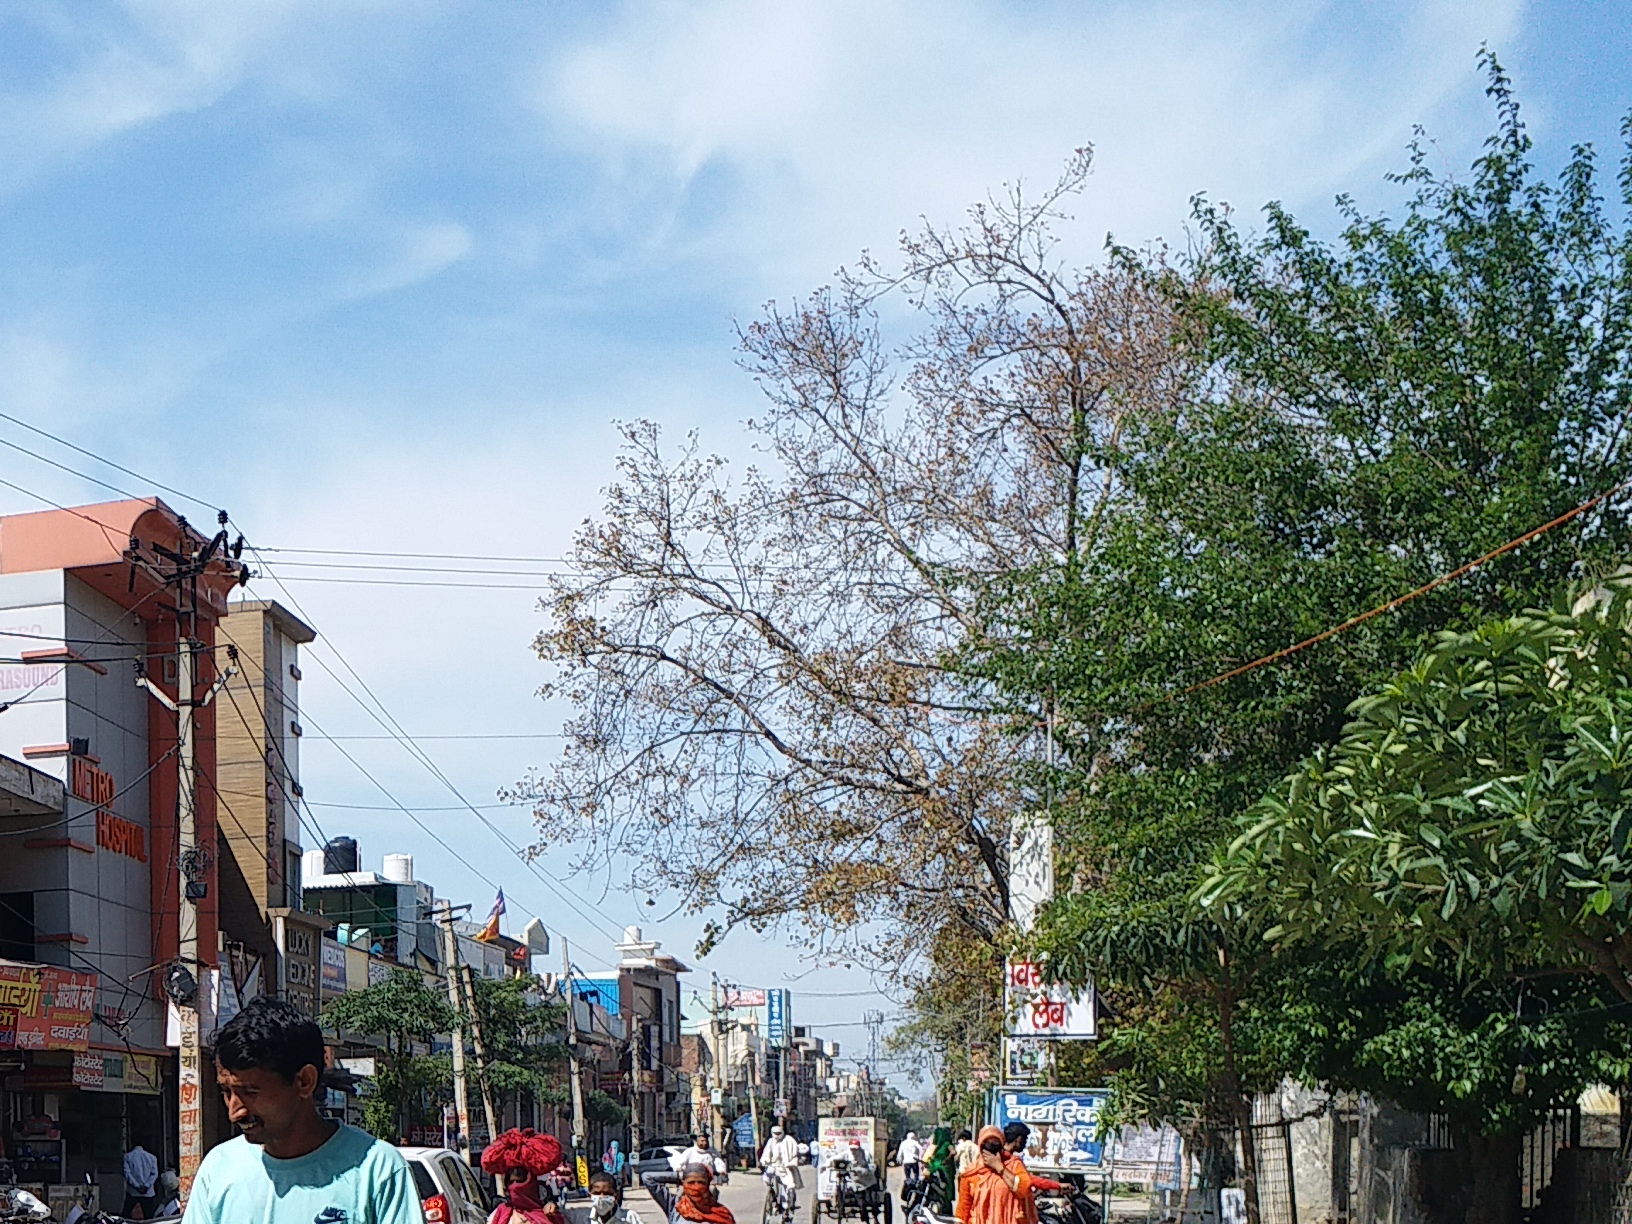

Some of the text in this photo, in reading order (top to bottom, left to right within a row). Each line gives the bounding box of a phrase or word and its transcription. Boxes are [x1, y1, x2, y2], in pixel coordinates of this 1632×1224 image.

[72, 758, 115, 809] METRO
[96, 808, 147, 863] HOSPITAL
[287, 928, 313, 958] LUCKY
